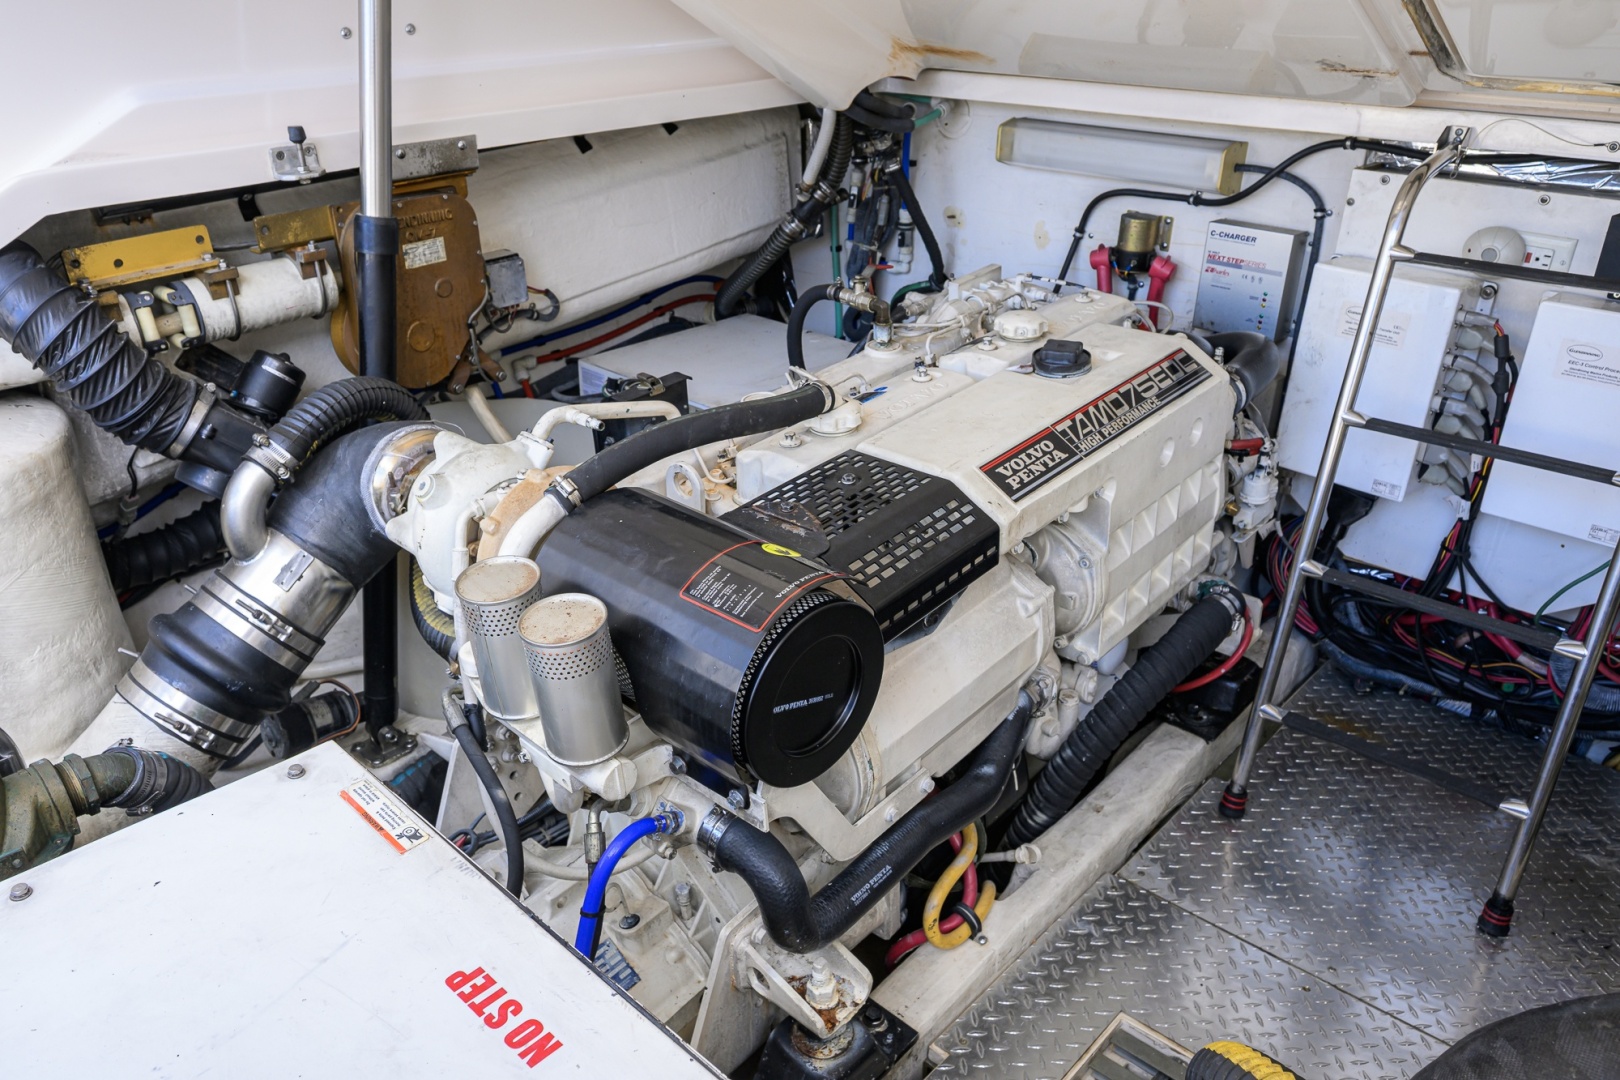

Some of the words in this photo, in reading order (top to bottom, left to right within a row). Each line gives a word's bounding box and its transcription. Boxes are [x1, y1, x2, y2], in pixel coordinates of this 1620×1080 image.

[1210, 230, 1257, 243] C-CHARGER
[1208, 254, 1226, 262] NEXT
[1078, 432, 1101, 452] HIGH
[1103, 396, 1161, 438] PERFORMANCE
[996, 440, 1055, 478] VOLVO
[1006, 450, 1069, 490] PENTA
[775, 581, 800, 598] VOLVO
[851, 883, 870, 901] VOLVO
[869, 865, 891, 885] PENTA
[445, 966, 523, 1029] STEP
[504, 1019, 563, 1068] NO
